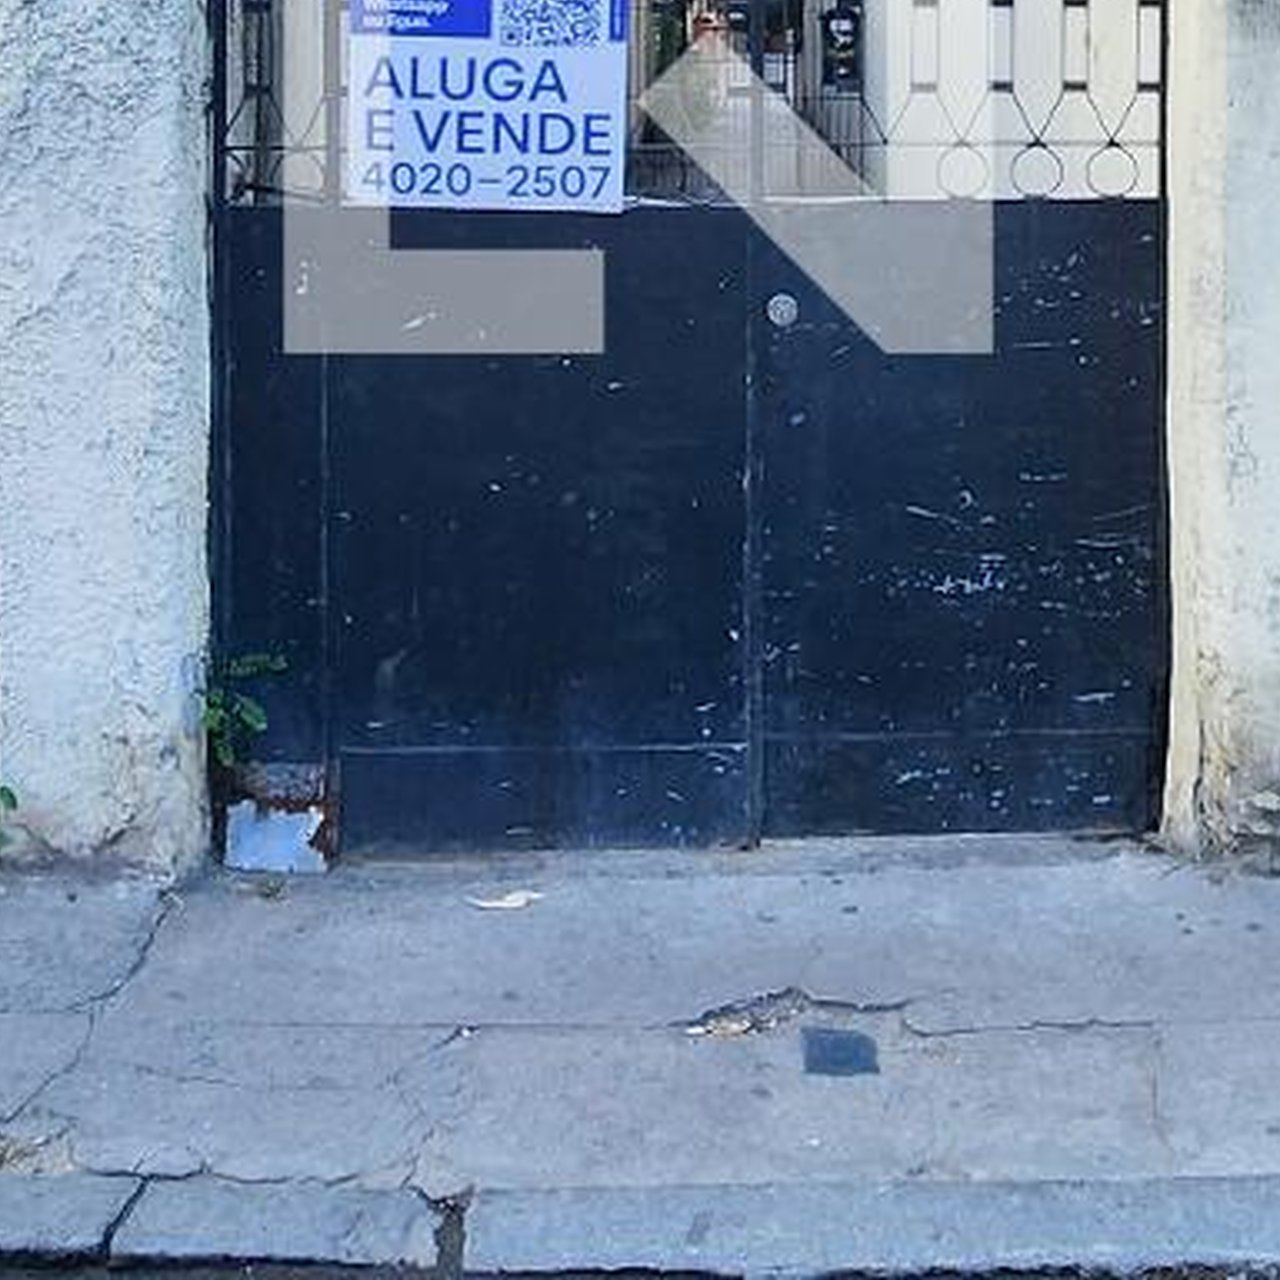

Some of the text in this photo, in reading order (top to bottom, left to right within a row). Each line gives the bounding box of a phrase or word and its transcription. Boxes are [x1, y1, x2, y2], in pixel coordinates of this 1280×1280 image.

[365, 57, 568, 103] ALUGA
[366, 110, 612, 156] E VENDE
[361, 161, 611, 199] 4020-2507
